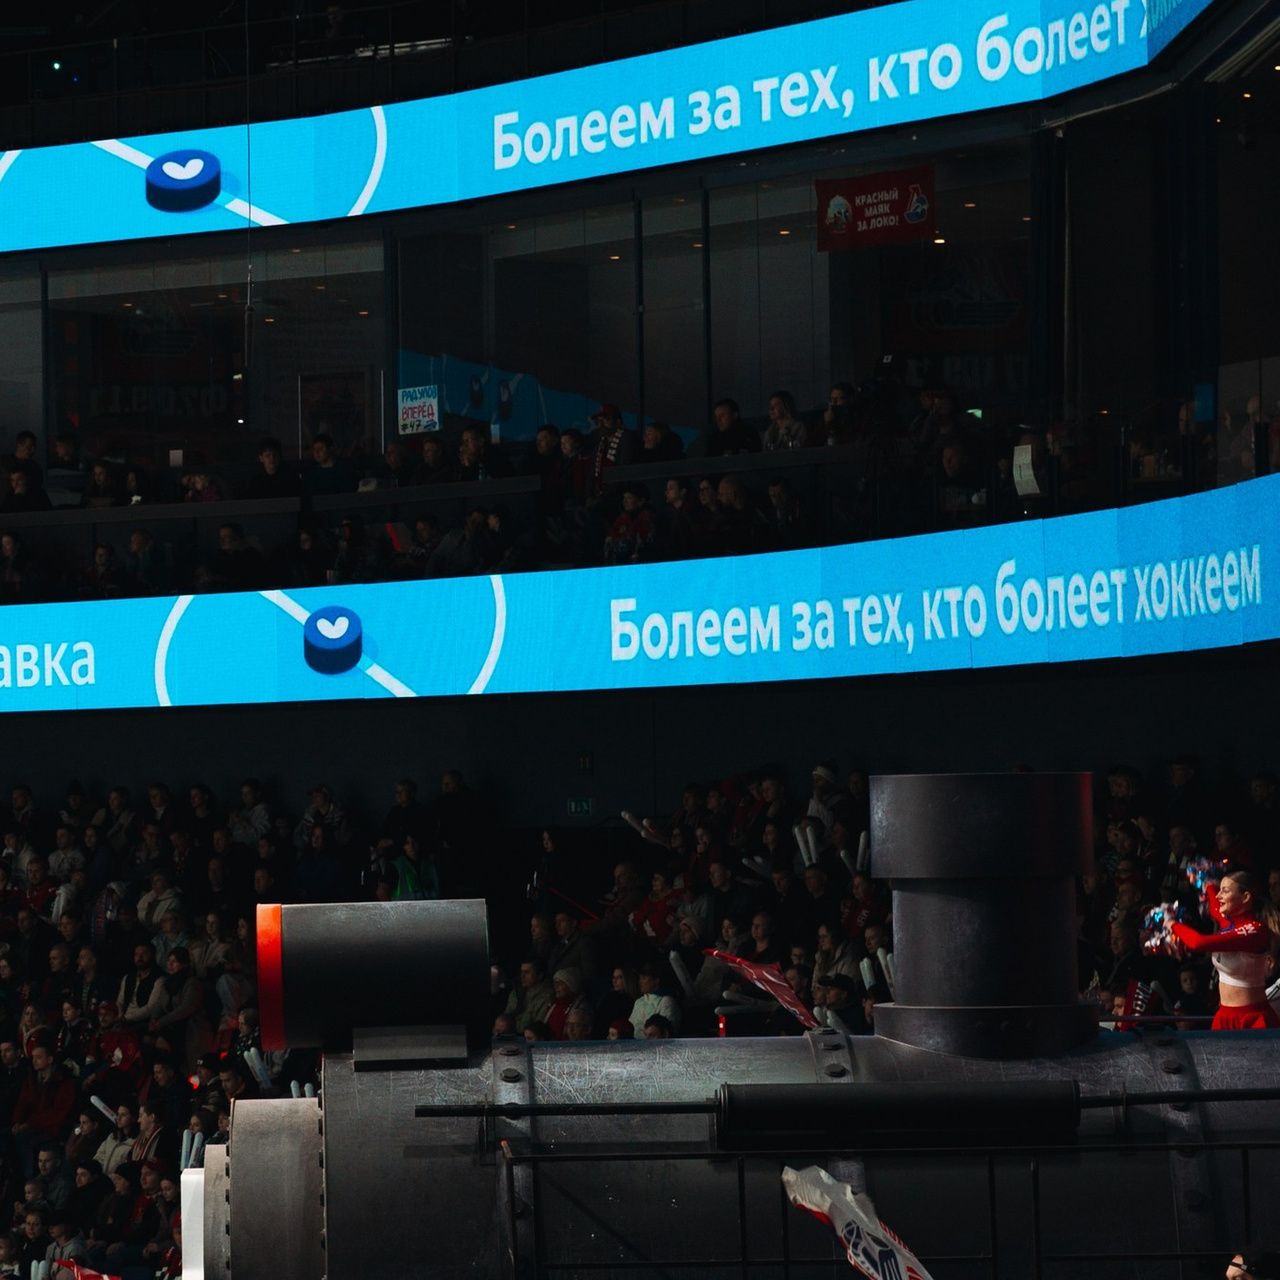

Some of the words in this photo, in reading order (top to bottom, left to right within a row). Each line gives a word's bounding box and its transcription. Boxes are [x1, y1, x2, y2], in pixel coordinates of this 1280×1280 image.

[495, 98, 675, 170] Болеем
[689, 85, 741, 135] за
[754, 67, 854, 121] тех,
[869, 44, 962, 101] кто
[855, 187, 899, 206] КРАСНЫЙ
[864, 201, 890, 217] МАЯК
[857, 219, 870, 233] ЗА
[869, 215, 899, 230] ЛОКО!
[610, 599, 780, 661] Болеем
[793, 601, 835, 650] за
[844, 596, 914, 652] тех,
[923, 587, 987, 639] кто
[996, 560, 1126, 633] болеет
[1135, 549, 1260, 619] хоккеем
